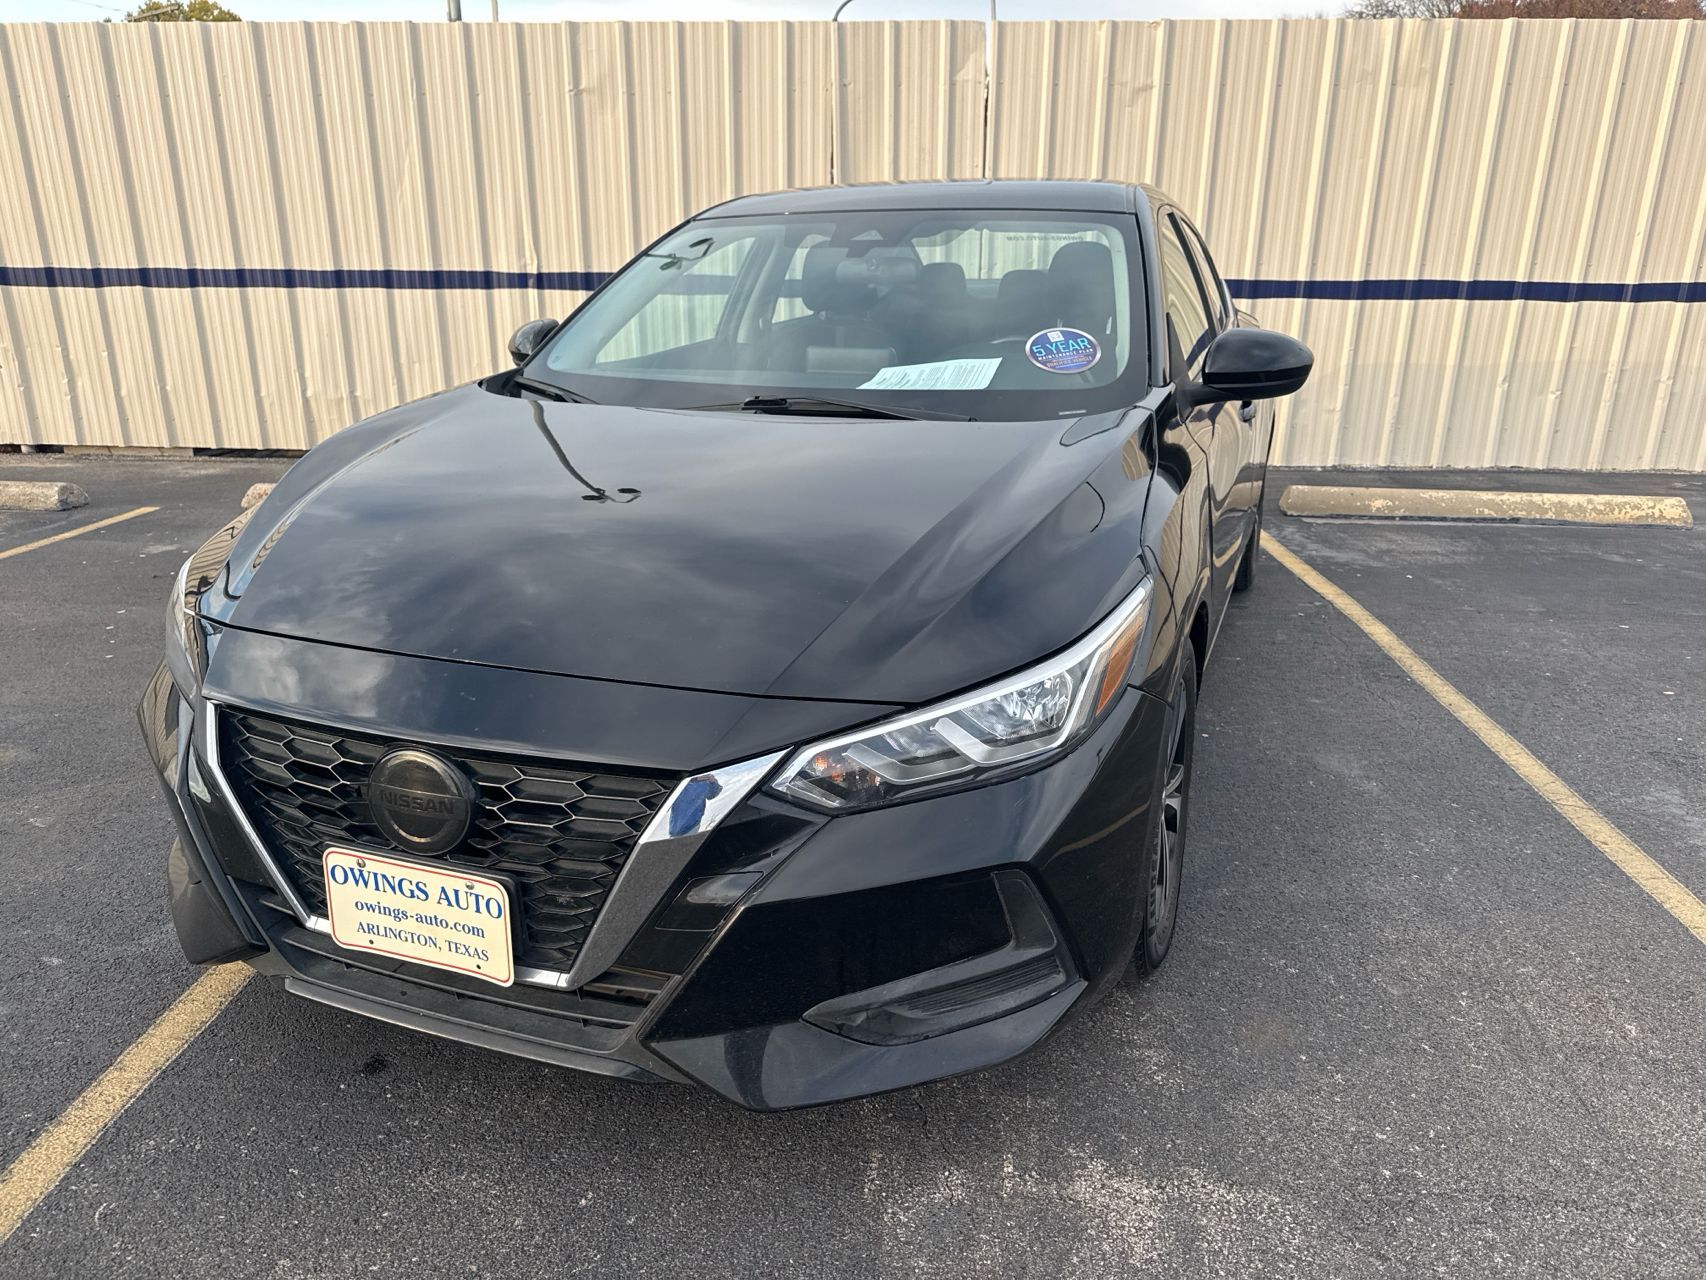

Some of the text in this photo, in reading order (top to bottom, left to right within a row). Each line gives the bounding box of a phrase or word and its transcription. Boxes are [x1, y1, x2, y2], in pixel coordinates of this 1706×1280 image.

[1032, 337, 1091, 357] 5 YEAR
[1037, 351, 1077, 361] MAINTENANCE
[380, 790, 455, 815] NISSAN
[330, 865, 503, 920] OWINGS AUTO
[355, 900, 485, 939] owings-auto.com
[356, 921, 489, 962] ARLINGTON, TEXAS
